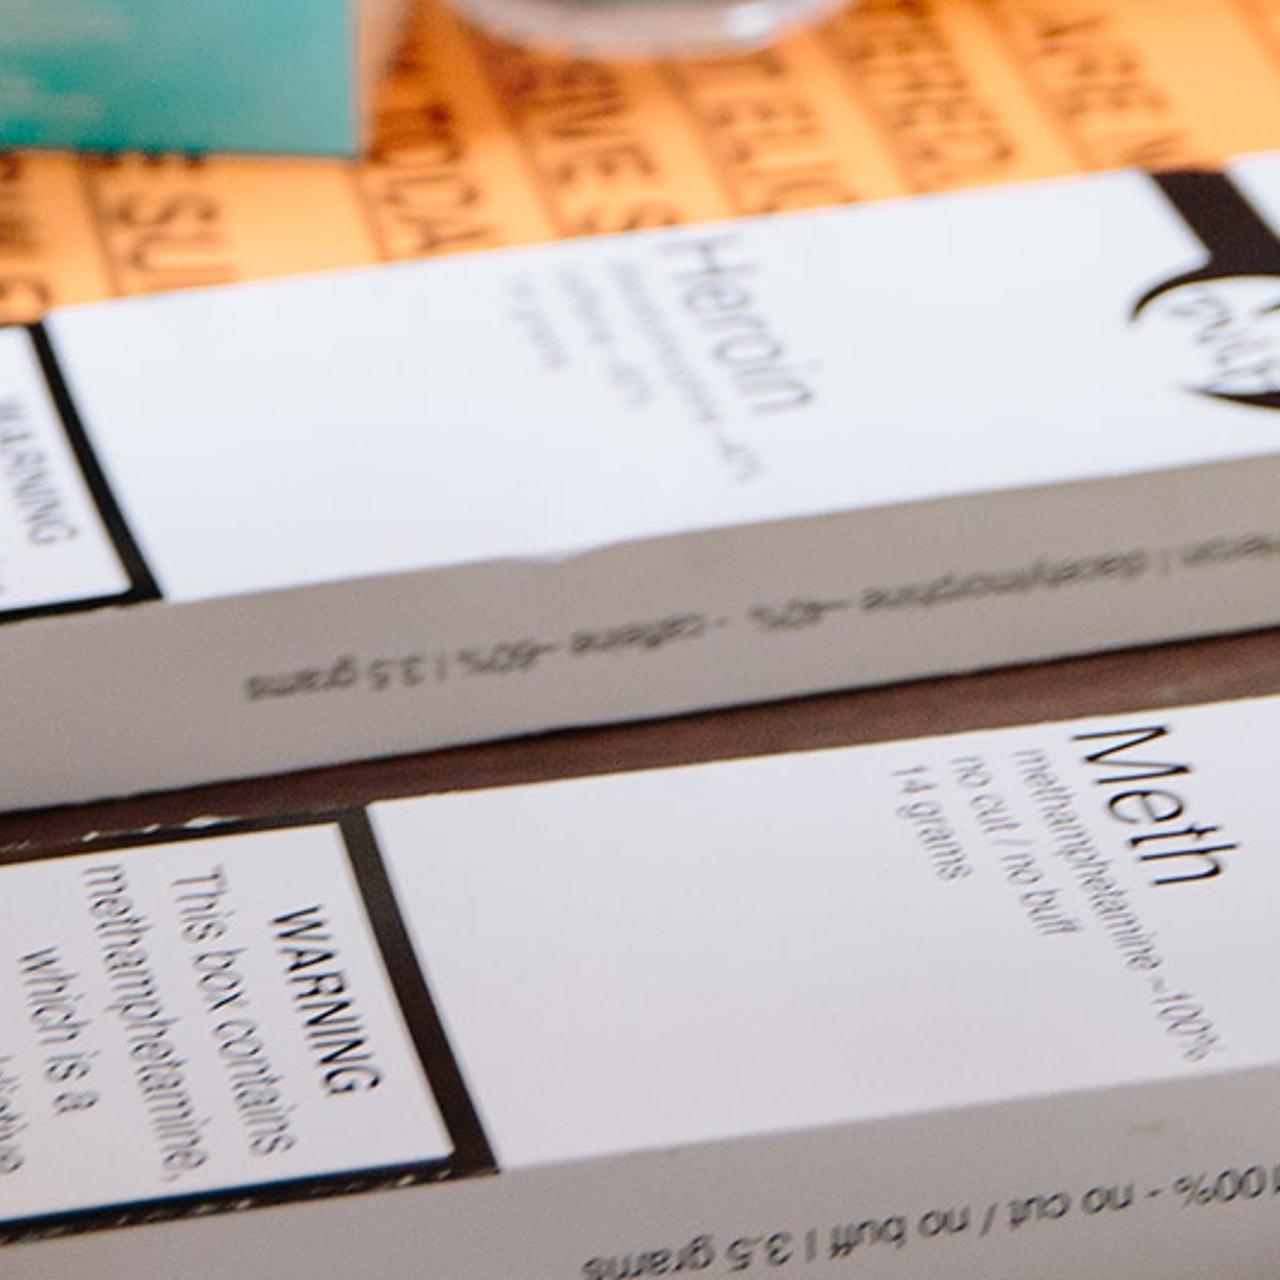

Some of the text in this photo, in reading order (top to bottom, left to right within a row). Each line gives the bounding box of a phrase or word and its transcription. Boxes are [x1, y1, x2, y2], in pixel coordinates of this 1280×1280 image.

[659, 234, 818, 415] Heroin
[244, 654, 357, 700] grams
[951, 755, 992, 789] no
[891, 765, 974, 882] 14 grams
[969, 792, 1022, 834] cut
[1071, 725, 1241, 887] Meth
[1000, 851, 1043, 886] no
[1014, 747, 1162, 972] methamphetamine
[1020, 887, 1085, 937] buff
[81, 864, 211, 1182] methamphetamine,
[170, 863, 300, 1156] This box contains
[269, 904, 384, 1096] WARNING
[19, 944, 102, 1117] which is a
[1009, 1193, 1069, 1227] cut
[1080, 1181, 1134, 1214] no
[829, 1214, 906, 1261] buff
[918, 1206, 970, 1239] no
[582, 1232, 714, 1280] grams
[726, 1230, 791, 1273] 3.5
